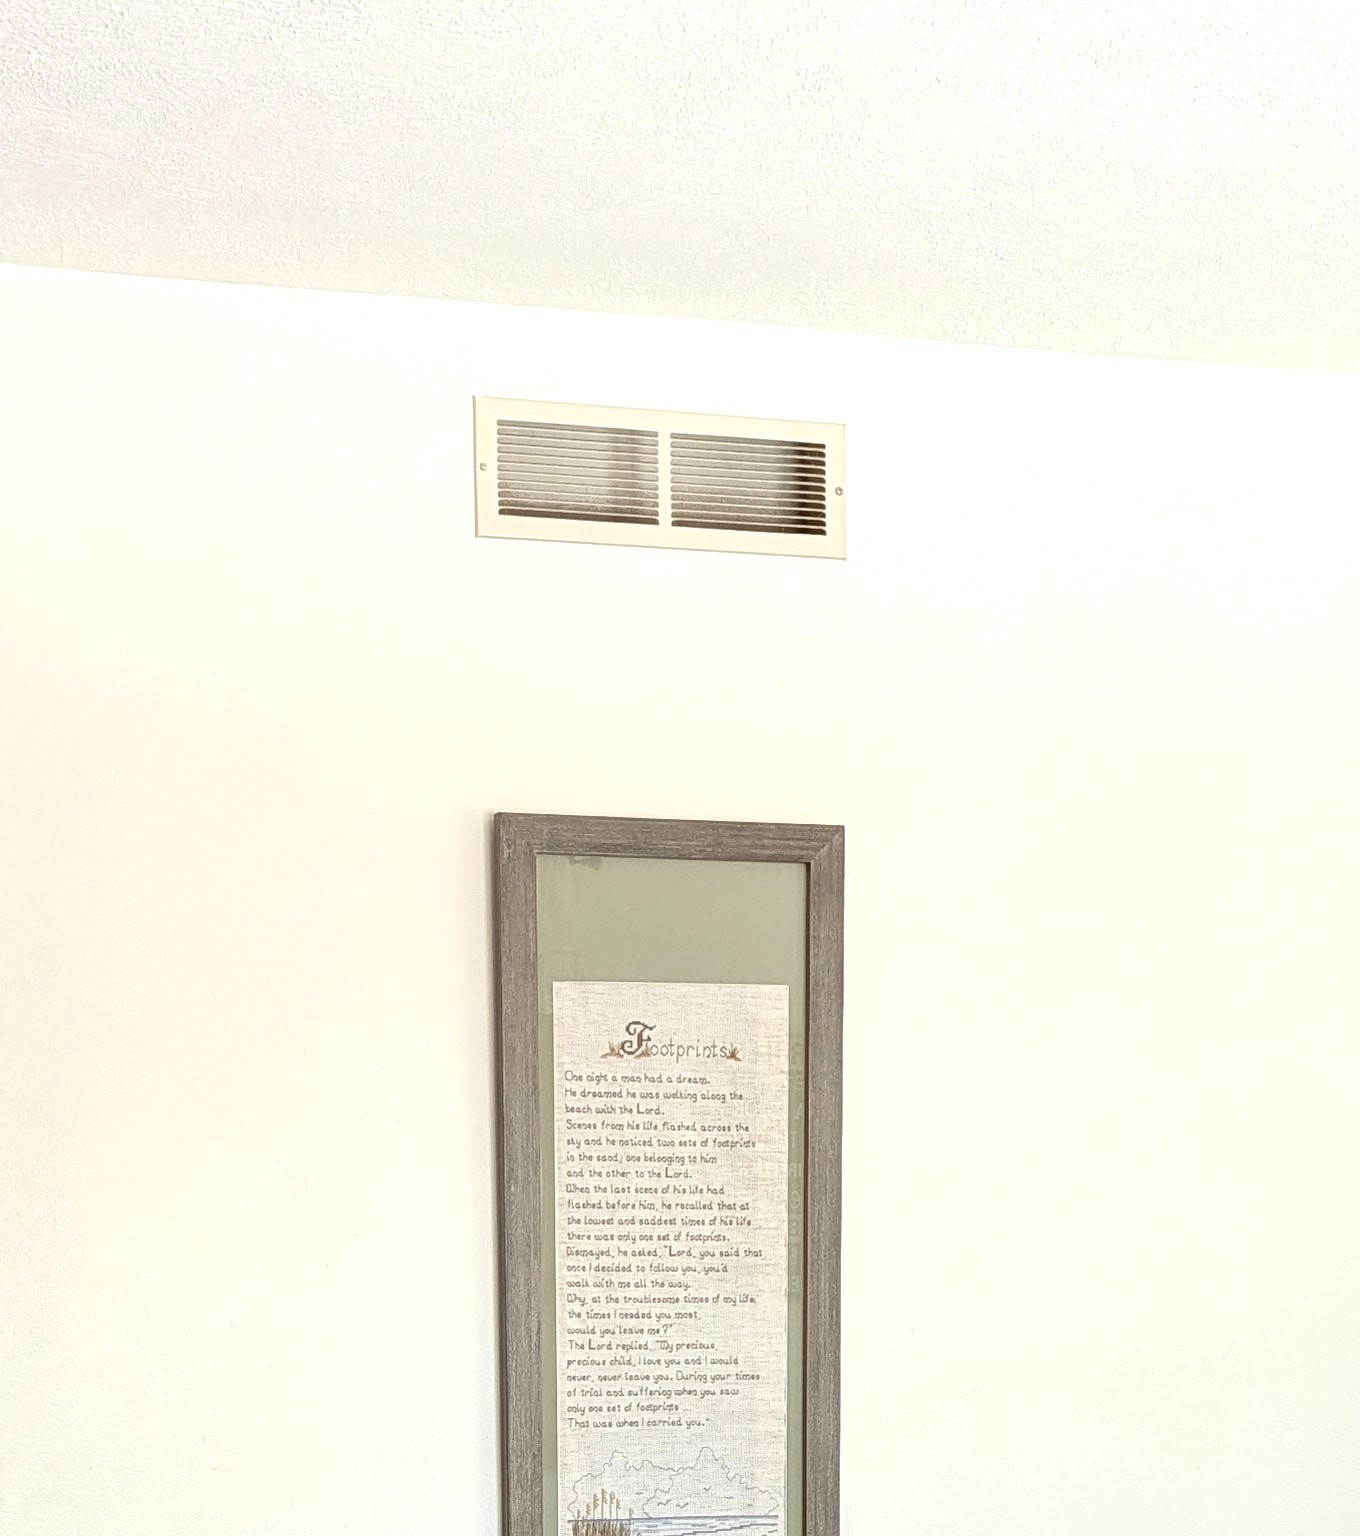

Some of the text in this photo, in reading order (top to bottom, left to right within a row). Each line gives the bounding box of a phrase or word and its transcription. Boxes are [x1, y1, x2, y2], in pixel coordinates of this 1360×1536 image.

[620, 1020, 728, 1063] Footprints
[565, 1069, 582, 1082] One
[586, 1073, 607, 1086] night
[621, 1075, 641, 1084] man
[645, 1073, 662, 1084] had
[667, 1076, 673, 1084] a
[676, 1073, 710, 1085] dream.
[565, 1087, 743, 1104] He dreamed he was walking along the
[565, 1102, 664, 1116] beach with the Lord.
[566, 1118, 749, 1133] Scenes from his life flashed across the
[567, 1136, 755, 1151] sky and he noticed two sets of footprints
[567, 1151, 717, 1167] in the one belonging to him
[567, 1166, 692, 1179] and the other to the Lord.
[566, 1183, 724, 1195] When the last scene of his life had
[568, 1198, 602, 1210] flashed
[606, 1199, 635, 1210] before
[662, 1200, 671, 1210] he
[675, 1200, 713, 1211] recalled
[718, 1200, 736, 1211] that
[740, 1202, 749, 1211] at
[568, 1215, 751, 1227] the lowest and saddest times of his life
[567, 1230, 730, 1245] there was only one set of footprints.
[618, 1246, 628, 1257] he
[700, 1250, 715, 1261] you
[720, 1247, 739, 1258] said
[744, 1247, 762, 1258] that
[567, 1265, 586, 1273] once
[595, 1263, 632, 1273] decided
[636, 1265, 645, 1273] to
[649, 1262, 678, 1273] follow
[567, 1278, 691, 1292] walk with me all the way.
[592, 1296, 601, 1304] at
[605, 1295, 619, 1304] the
[624, 1294, 679, 1305] troublesome
[684, 1295, 708, 1304] times
[712, 1293, 719, 1304] of
[724, 1296, 736, 1307] my
[569, 1309, 581, 1319] the
[586, 1311, 610, 1320] times
[619, 1310, 652, 1320] needed
[655, 1312, 671, 1323] you
[567, 1325, 644, 1339] would you leave
[569, 1338, 612, 1351] The Lord
[567, 1359, 606, 1370] precious
[643, 1356, 661, 1366] love
[665, 1358, 680, 1369] you
[684, 1355, 701, 1366] and
[710, 1355, 738, 1366] would
[598, 1374, 621, 1382] never
[625, 1371, 650, 1382] leave
[653, 1374, 673, 1385] you.
[676, 1370, 707, 1384] During
[710, 1373, 730, 1384] your
[735, 1372, 760, 1381] times
[567, 1386, 739, 1400] of trial and suffering when you saw
[567, 1401, 679, 1417] only one set of footprints
[569, 1417, 589, 1429] That
[616, 1418, 639, 1428] when
[647, 1417, 682, 1427] carried
